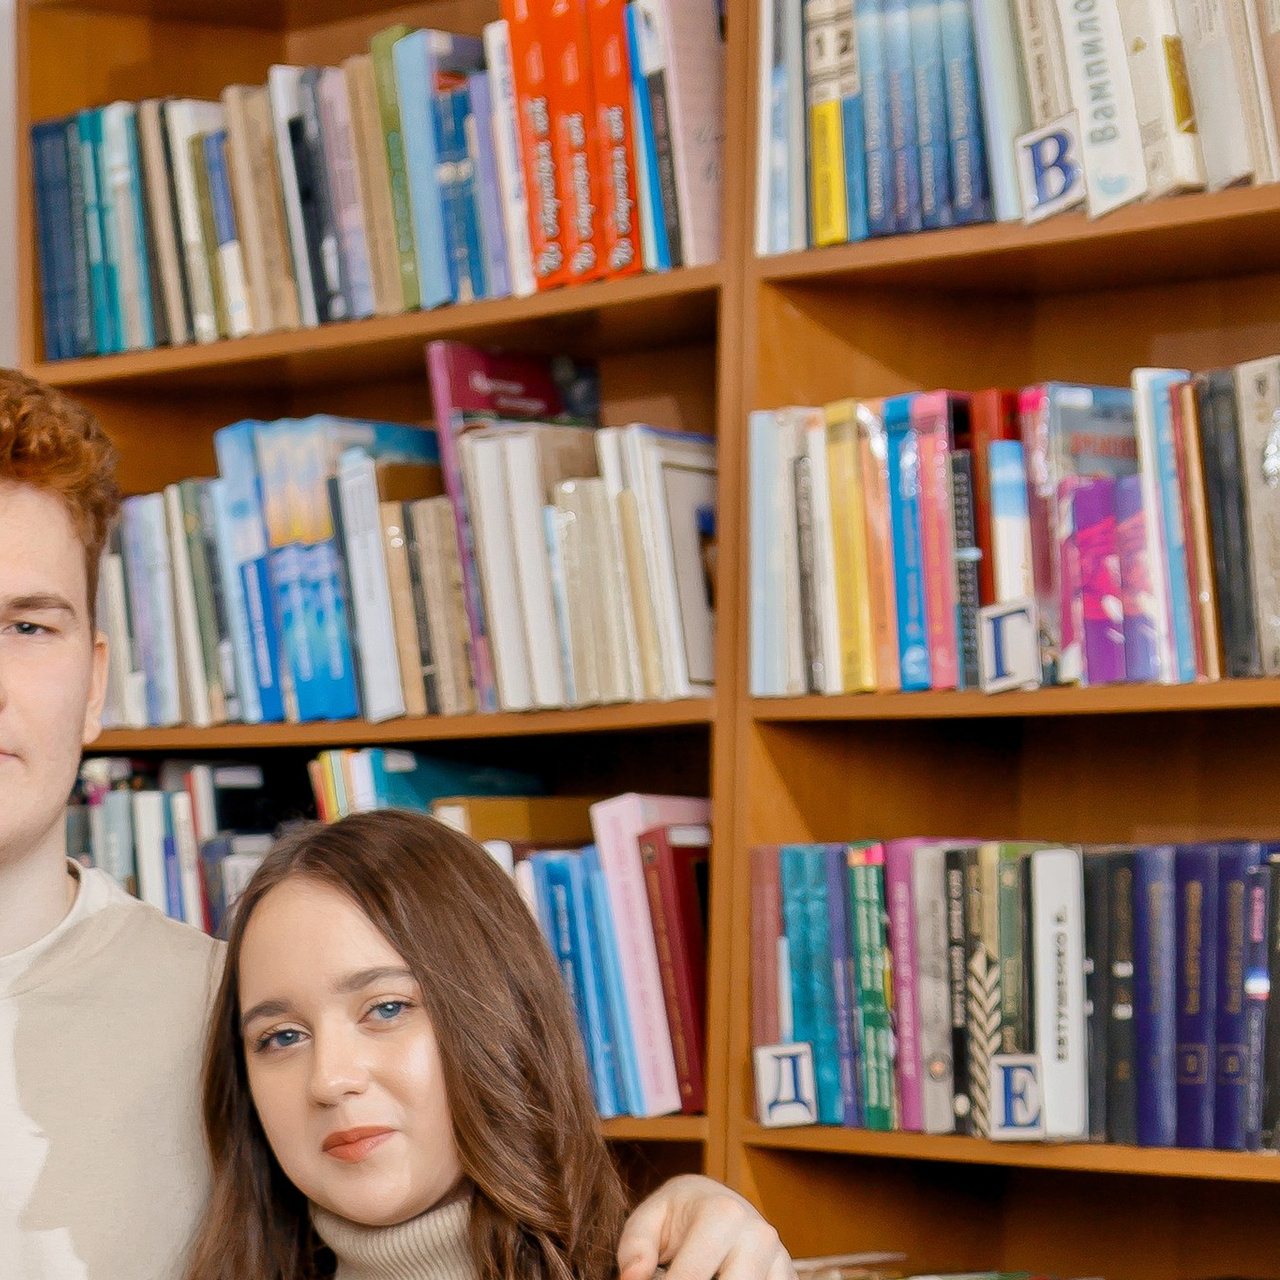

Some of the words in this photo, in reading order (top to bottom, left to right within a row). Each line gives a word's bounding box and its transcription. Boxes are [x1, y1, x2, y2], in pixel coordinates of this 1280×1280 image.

[1024, 132, 1076, 207] В
[989, 607, 1028, 679] Г
[768, 1054, 815, 1121] Д
[1002, 1063, 1042, 1128] Е
